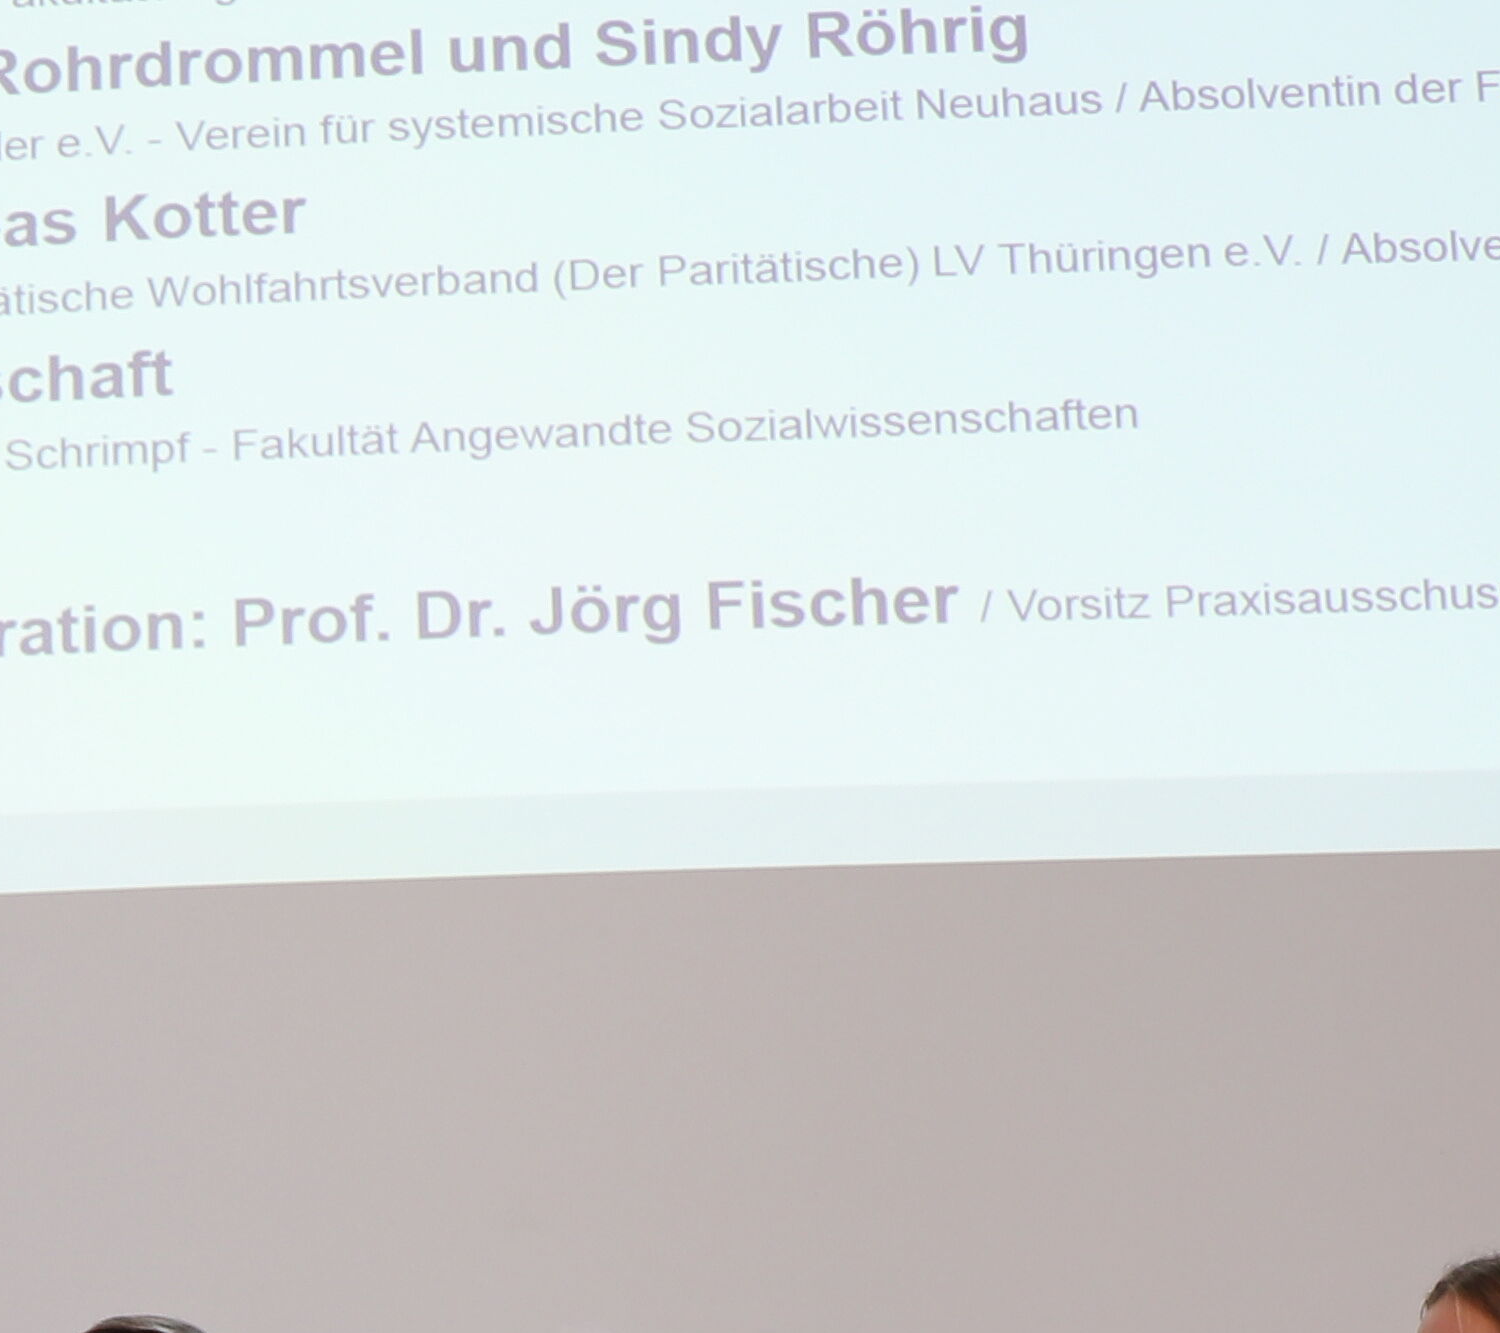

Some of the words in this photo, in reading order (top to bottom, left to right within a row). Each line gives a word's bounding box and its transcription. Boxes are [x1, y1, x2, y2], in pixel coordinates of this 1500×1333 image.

[450, 22, 570, 72] und
[597, 15, 782, 73] Sindy
[808, 5, 1027, 63] Röhrig
[57, 124, 131, 158] e.V.
[176, 121, 305, 150] Verein
[320, 114, 374, 145] für
[389, 103, 643, 149] systemische
[660, 90, 903, 129] Sozialarbeit
[917, 87, 1103, 119] Neuhaus
[1116, 82, 1127, 113] /
[1140, 75, 1380, 112] Absolventin
[1395, 73, 1462, 104] der
[106, 192, 306, 241] Kotter
[147, 262, 538, 307] Wohlfahrtsverband
[554, 259, 643, 299] (Der
[659, 247, 919, 286] Paritätische)
[934, 244, 984, 276] LV
[999, 241, 1210, 279] Thüringen
[1225, 234, 1300, 266] e.V.
[1317, 234, 1329, 265] /
[6, 432, 190, 472] Schrimpf
[234, 423, 398, 460] Fakultät
[411, 414, 671, 460] Angewandte
[688, 399, 1138, 442] Sozialwissenschaften
[235, 593, 389, 646] Prof.
[418, 591, 505, 639] Dr.
[530, 585, 680, 644] Jörg
[709, 577, 959, 629] Fischer
[981, 590, 993, 622] /
[1007, 587, 1150, 621] Vorsitz
